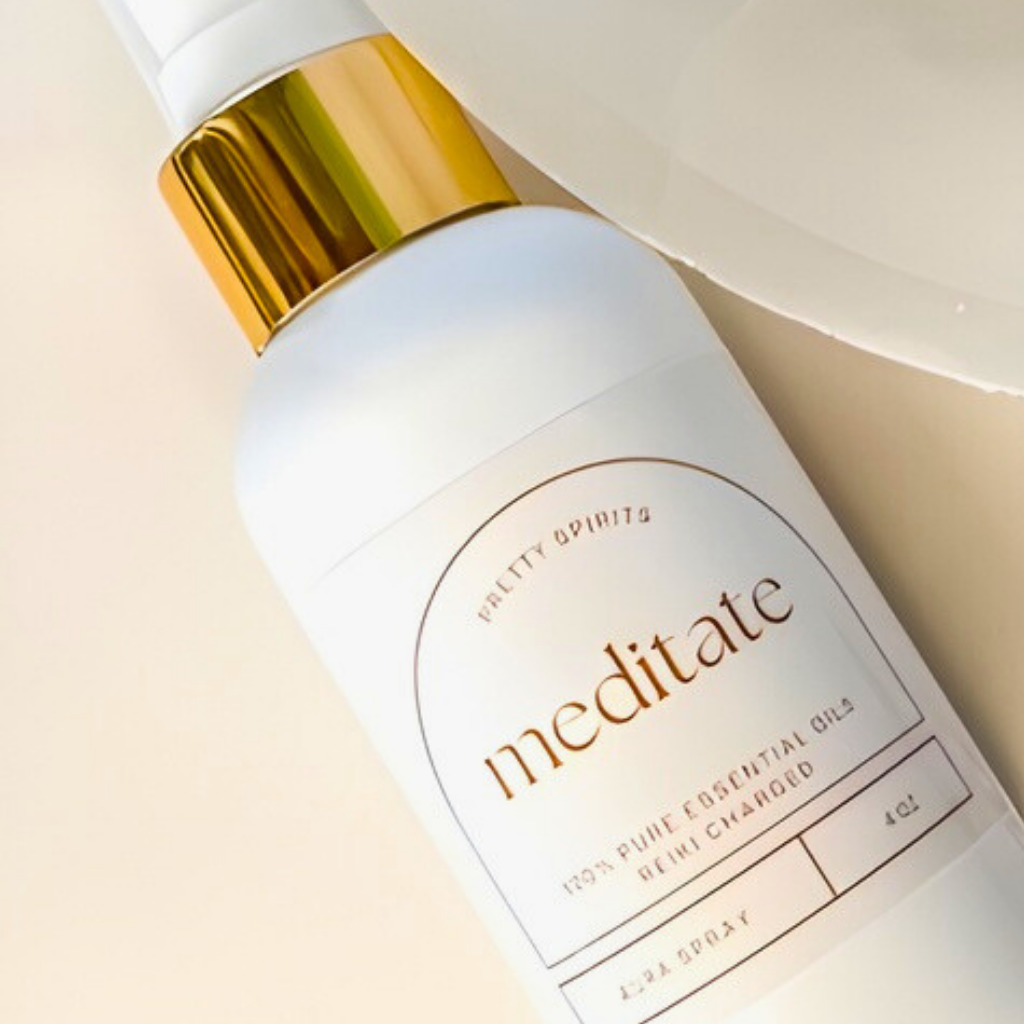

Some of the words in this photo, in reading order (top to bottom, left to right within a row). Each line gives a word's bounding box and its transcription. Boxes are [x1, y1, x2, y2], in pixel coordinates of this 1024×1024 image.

[477, 541, 546, 623] PRETTY
[484, 576, 794, 800] meditate
[617, 813, 678, 861] PURE
[683, 731, 808, 820] ESSENTIAL
[810, 697, 854, 734] OILS
[638, 836, 700, 881] REIKI
[620, 962, 671, 1001] ARA
